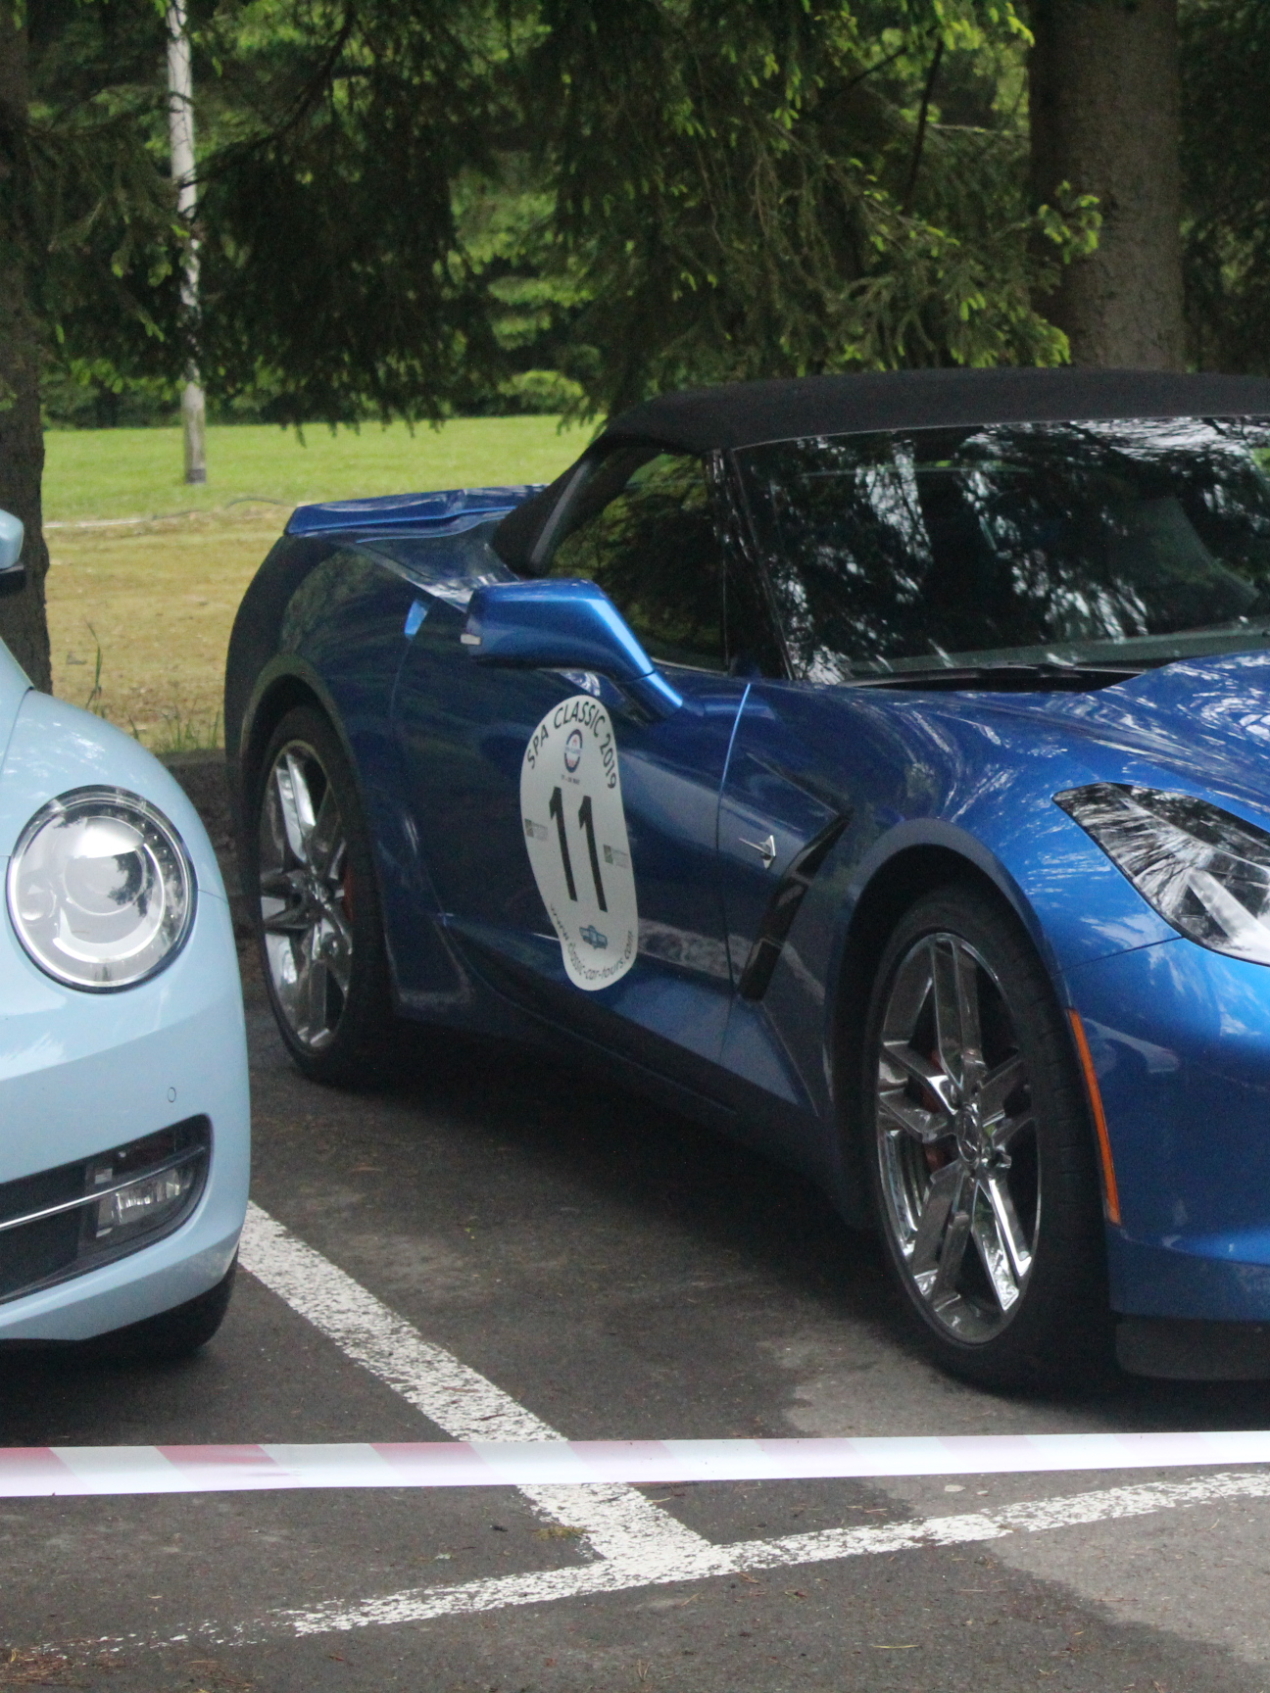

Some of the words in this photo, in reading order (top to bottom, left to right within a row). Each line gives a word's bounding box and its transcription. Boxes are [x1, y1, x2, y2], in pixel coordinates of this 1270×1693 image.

[527, 724, 549, 769] SPA
[553, 701, 605, 737] CLASSIC
[599, 734, 617, 789] 2019
[549, 786, 608, 912] 11
